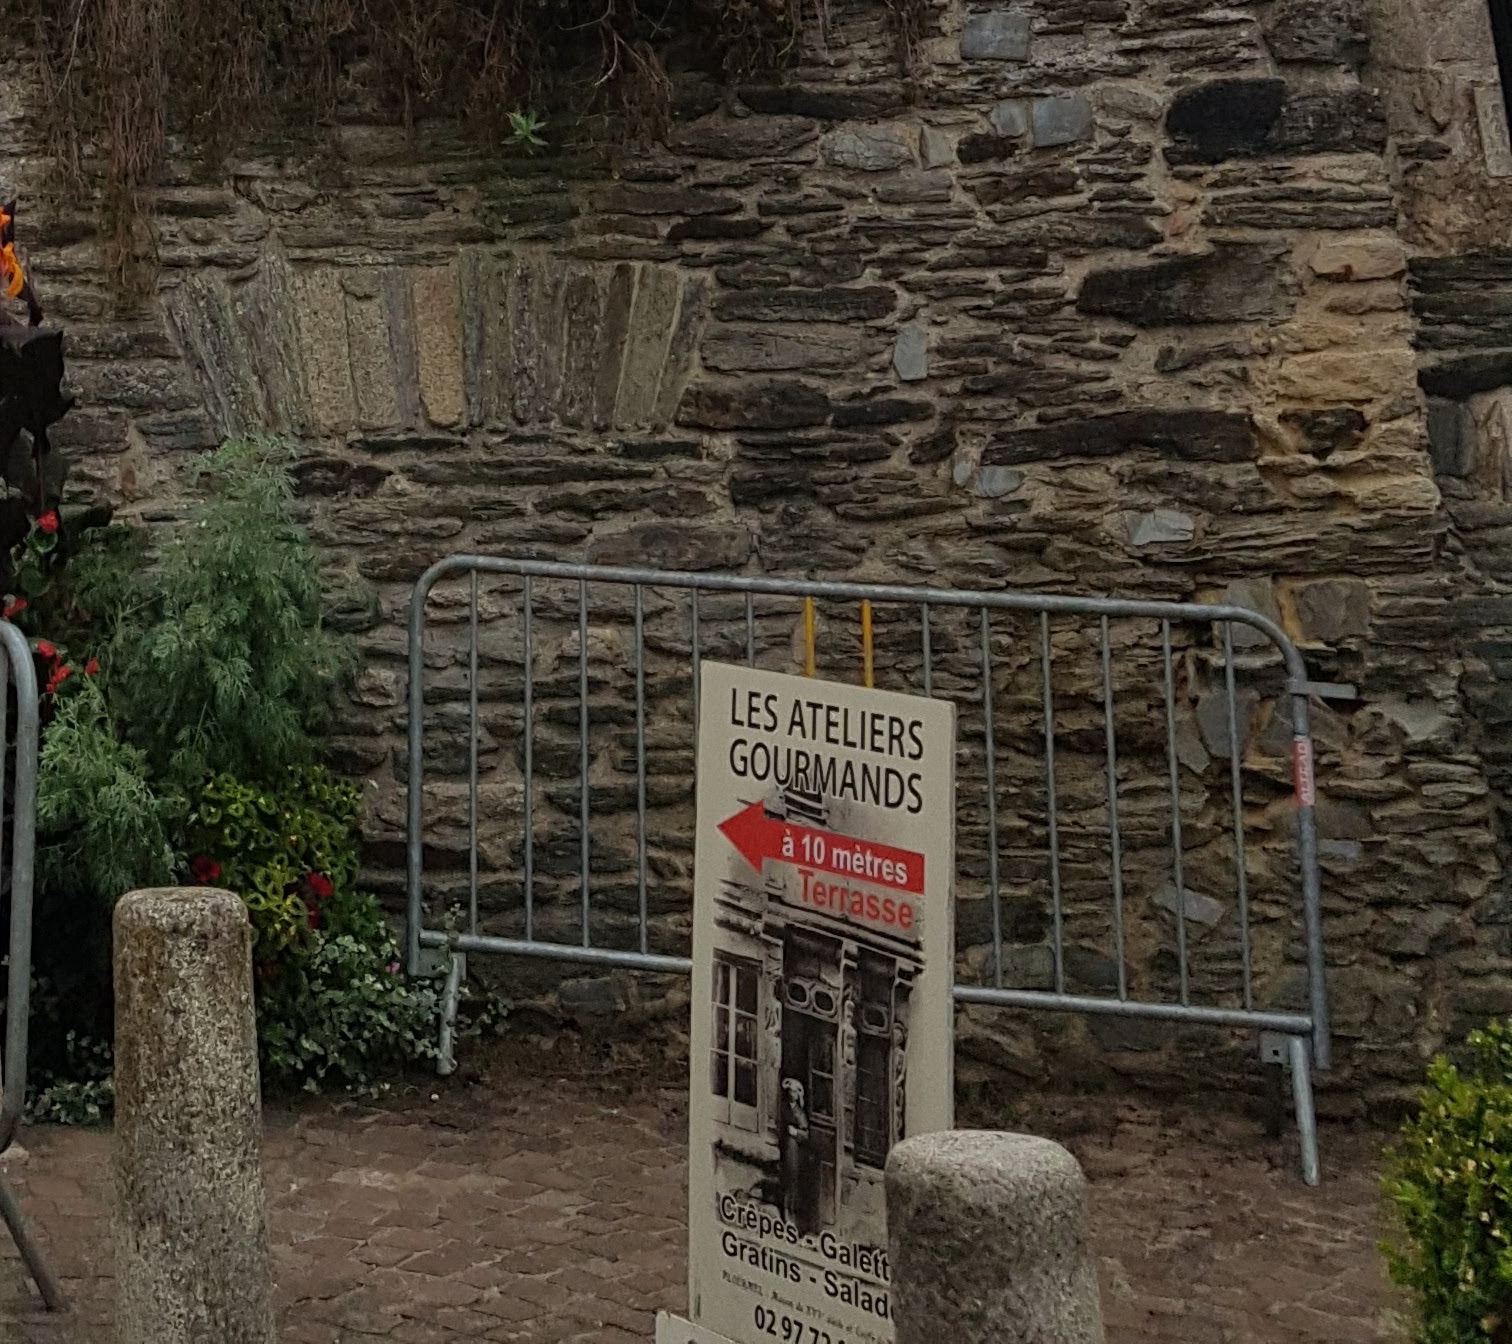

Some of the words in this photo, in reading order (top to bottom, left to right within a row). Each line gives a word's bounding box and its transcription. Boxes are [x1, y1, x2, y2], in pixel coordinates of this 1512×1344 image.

[731, 687, 778, 733] LES
[787, 698, 924, 760] ATELIERS
[729, 738, 923, 814] GOURMANDS
[782, 828, 794, 857] à
[801, 834, 826, 865] 10
[832, 844, 909, 885] mètres
[797, 868, 914, 930] Terrasse
[721, 1195, 797, 1245] Crêpes
[820, 1232, 891, 1281] Galett
[721, 1231, 801, 1283] Gratins
[824, 1270, 895, 1321] Salad
[754, 1304, 777, 1337] 02
[782, 1316, 803, 1344] 97
